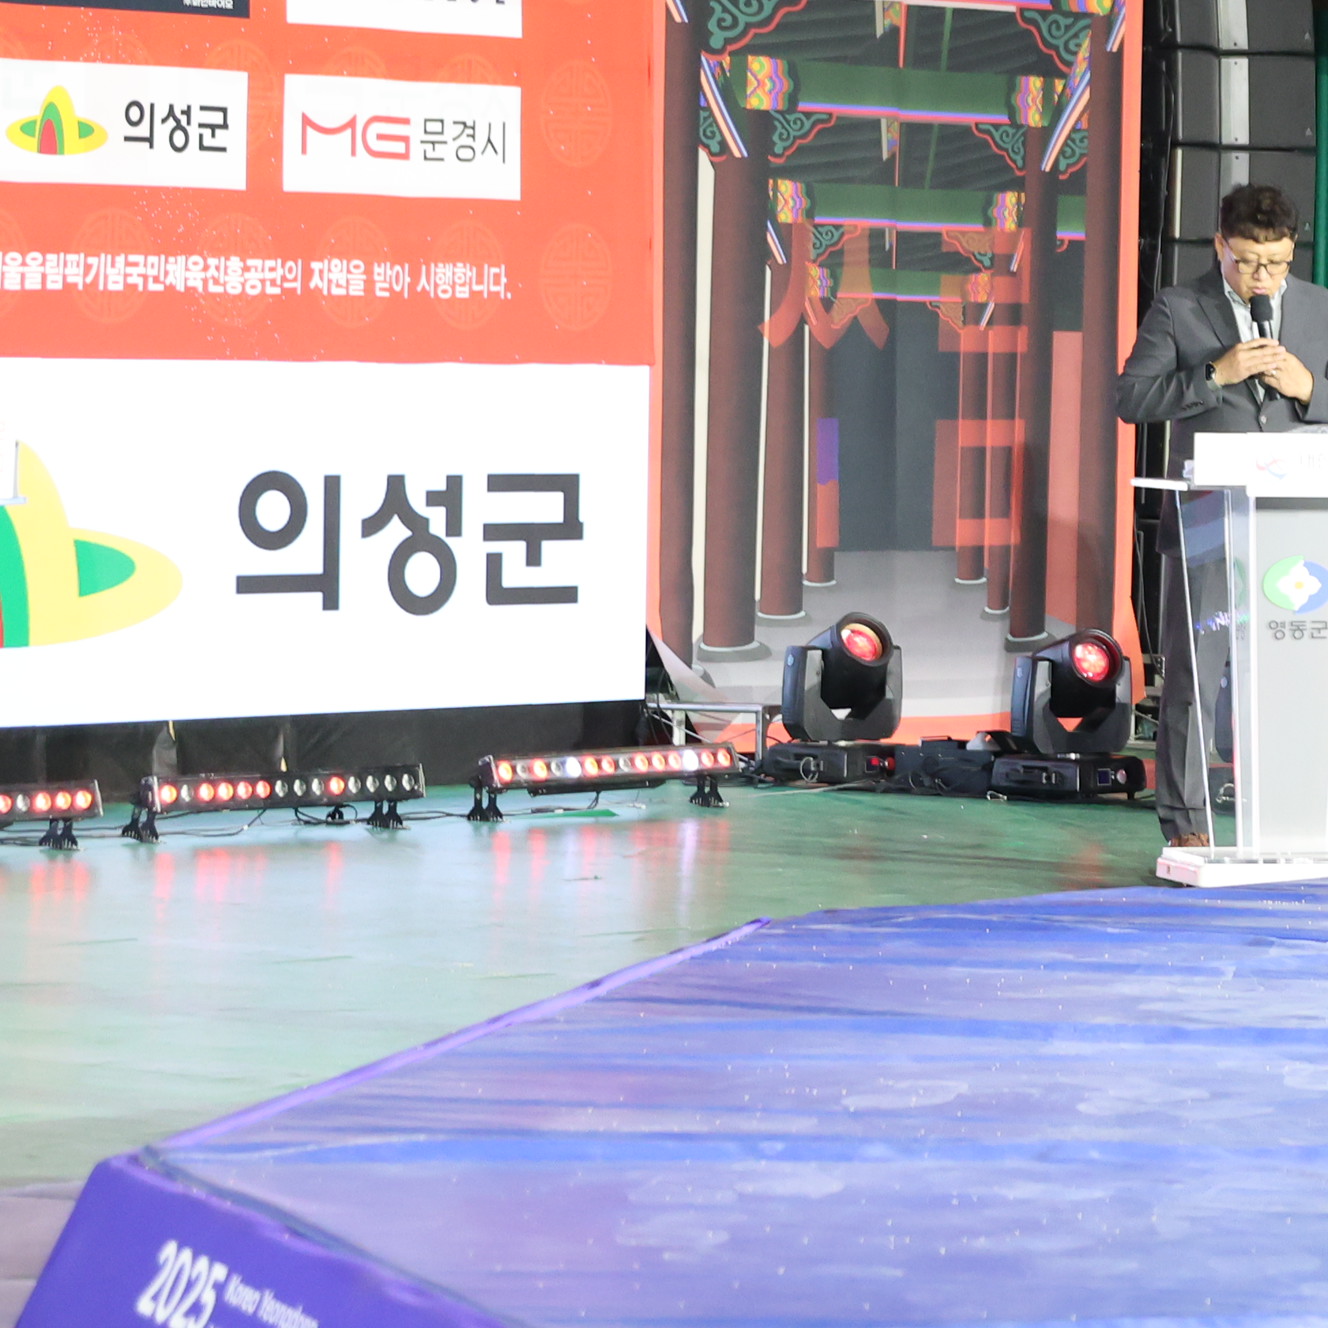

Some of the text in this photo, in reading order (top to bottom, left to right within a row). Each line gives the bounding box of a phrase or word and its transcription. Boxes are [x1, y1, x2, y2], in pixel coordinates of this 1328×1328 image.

[123, 100, 229, 153] 의성군
[301, 112, 506, 164] MG 문경시
[0, 250, 512, 300] 울올림픽기념국민체육진흥공단의 지원을 받아 시행합니다.
[235, 470, 584, 616] 의성군
[1267, 620, 1328, 641] 영동군
[136, 1239, 228, 1328] 2025
